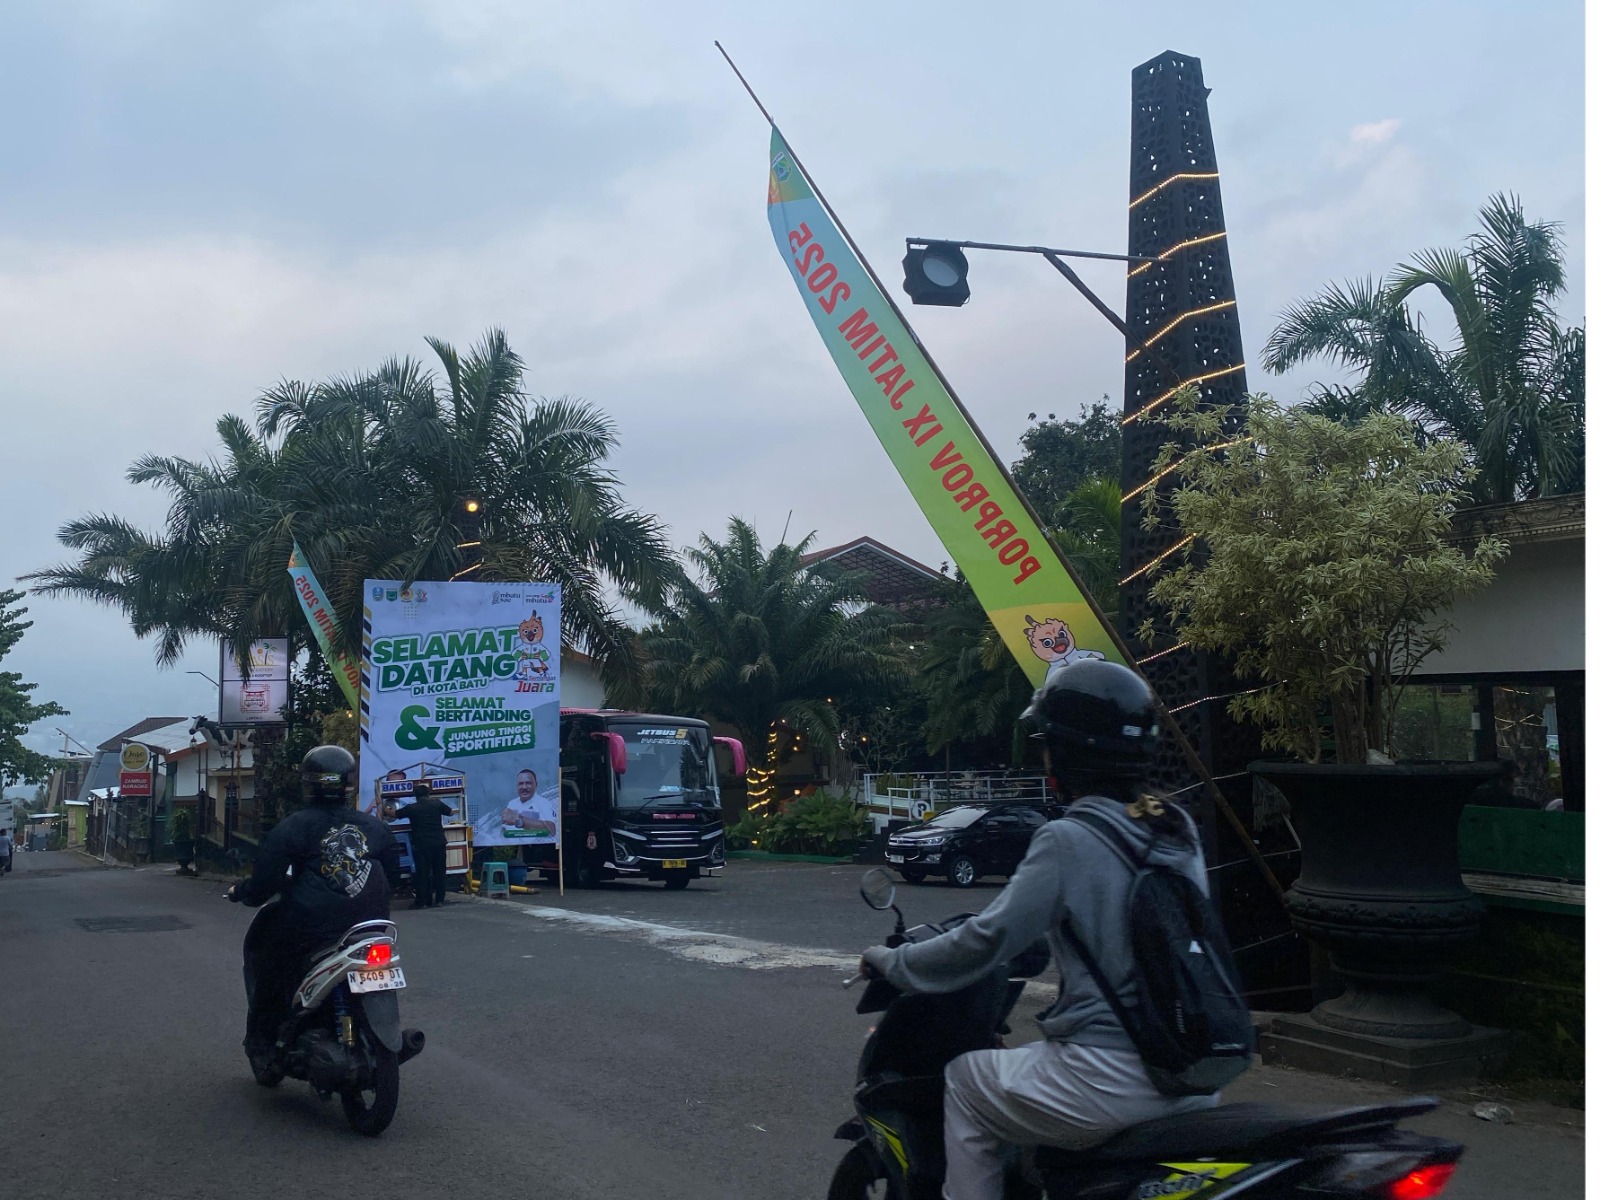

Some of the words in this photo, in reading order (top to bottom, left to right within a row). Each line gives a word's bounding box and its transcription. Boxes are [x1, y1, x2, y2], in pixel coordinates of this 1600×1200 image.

[373, 628, 518, 663] SELAMAT
[381, 654, 516, 689] DATANG
[413, 686, 424, 695] DI
[429, 681, 458, 694] KOTA
[459, 679, 488, 691] BATU
[514, 680, 555, 692] Juara
[435, 697, 505, 710] SELAMAT
[435, 709, 532, 723] BERTANDING
[395, 705, 446, 751] &
[449, 728, 496, 742] JUNJUNG
[499, 725, 532, 737] TINGGI
[448, 734, 532, 752] SPORTIFITAS
[383, 783, 413, 792] BAKSO
[433, 779, 463, 788] AREMA
[349, 972, 356, 983] N
